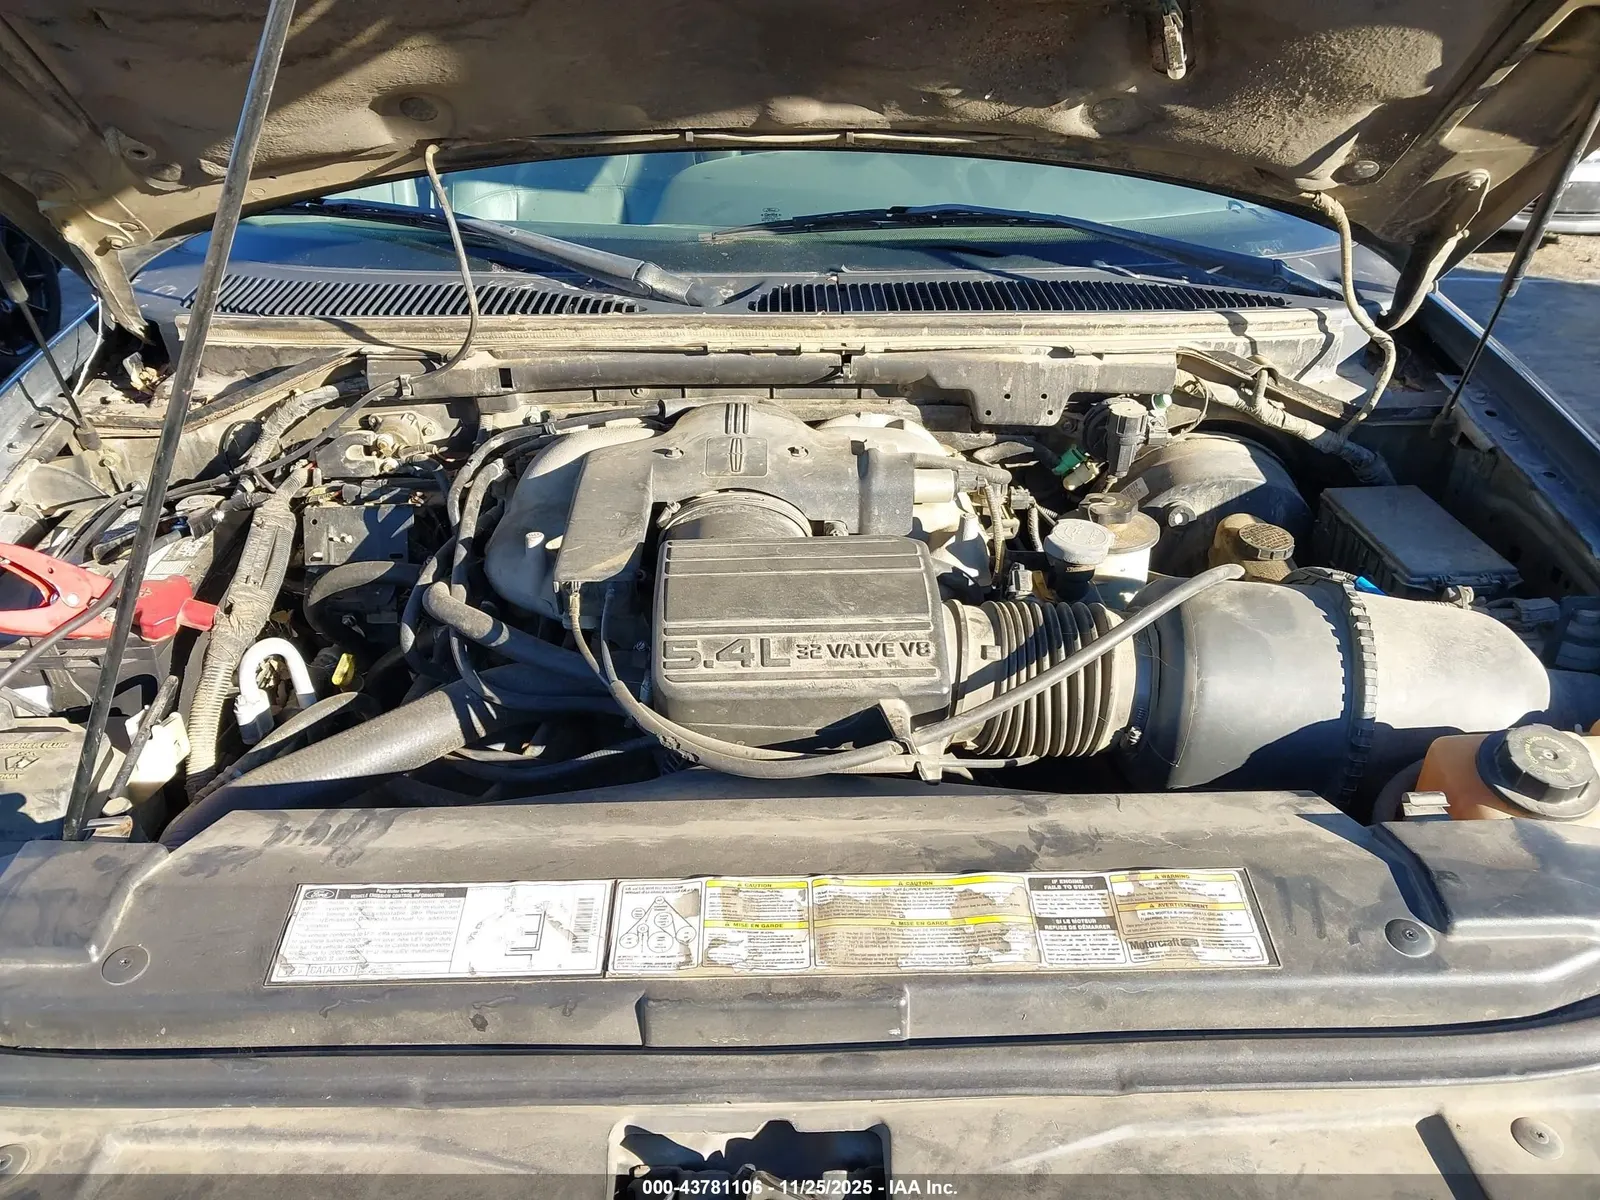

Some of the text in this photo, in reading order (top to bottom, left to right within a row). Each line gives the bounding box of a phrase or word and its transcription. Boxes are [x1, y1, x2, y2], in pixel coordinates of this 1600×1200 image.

[662, 638, 932, 670] 5.4L 32 VALVE V8
[1128, 938, 1182, 951] Motorcraft
[309, 965, 356, 974] CATALYST
